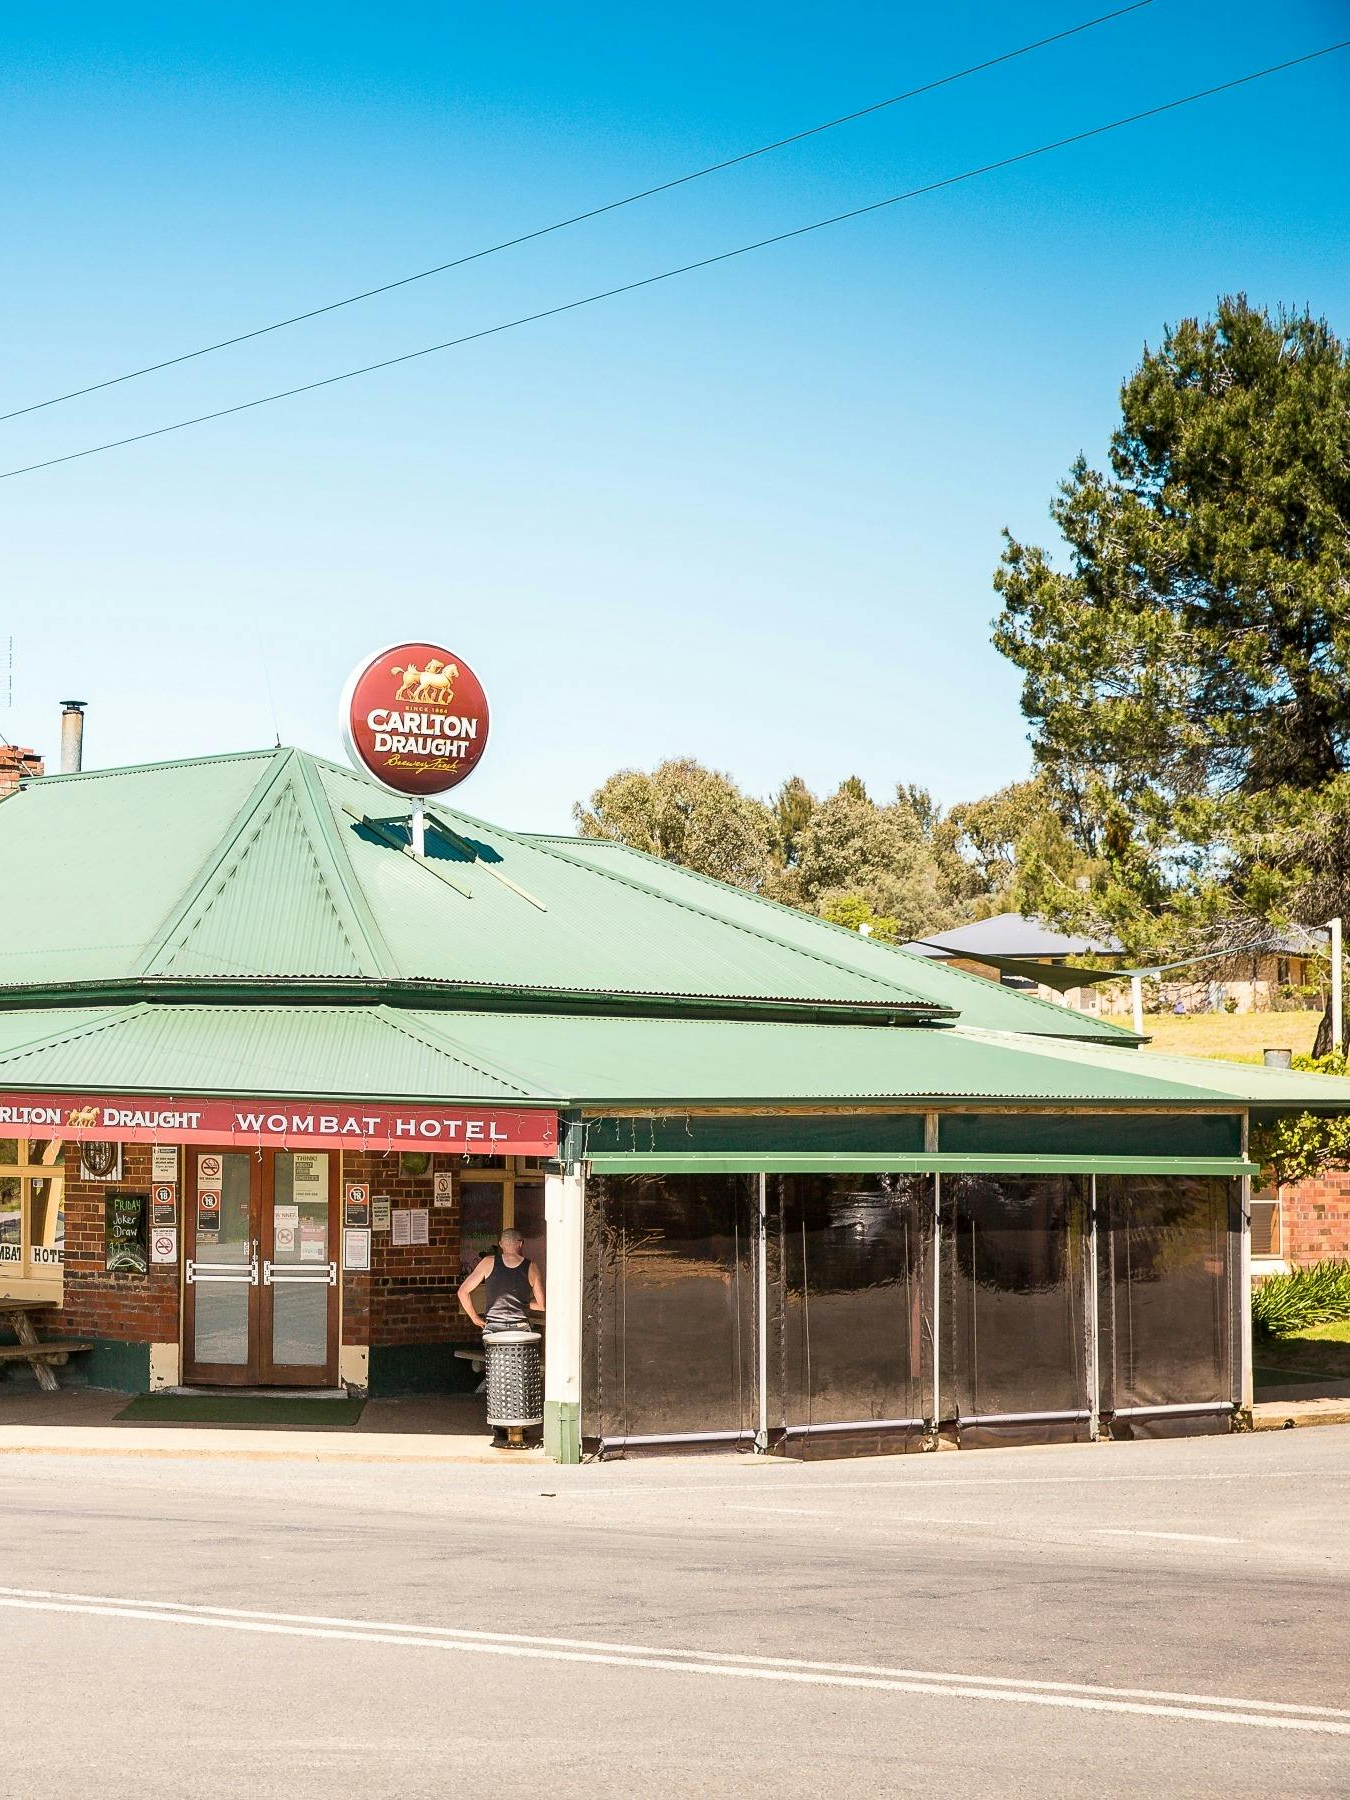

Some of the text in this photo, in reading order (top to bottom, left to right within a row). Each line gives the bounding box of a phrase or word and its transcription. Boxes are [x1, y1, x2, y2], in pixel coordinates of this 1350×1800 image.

[367, 708, 478, 739] CARLTON
[374, 732, 470, 758] DRAUGHT
[383, 754, 459, 775] Brewery Fresh
[103, 1108, 201, 1129] DRAUGHT
[235, 1113, 381, 1135] WOMBAT
[396, 1119, 508, 1140] HOTEL
[159, 1192, 168, 1200] 18
[114, 1199, 141, 1212] FRIDAY
[113, 1212, 137, 1224] Joker
[113, 1225, 137, 1237] Draw
